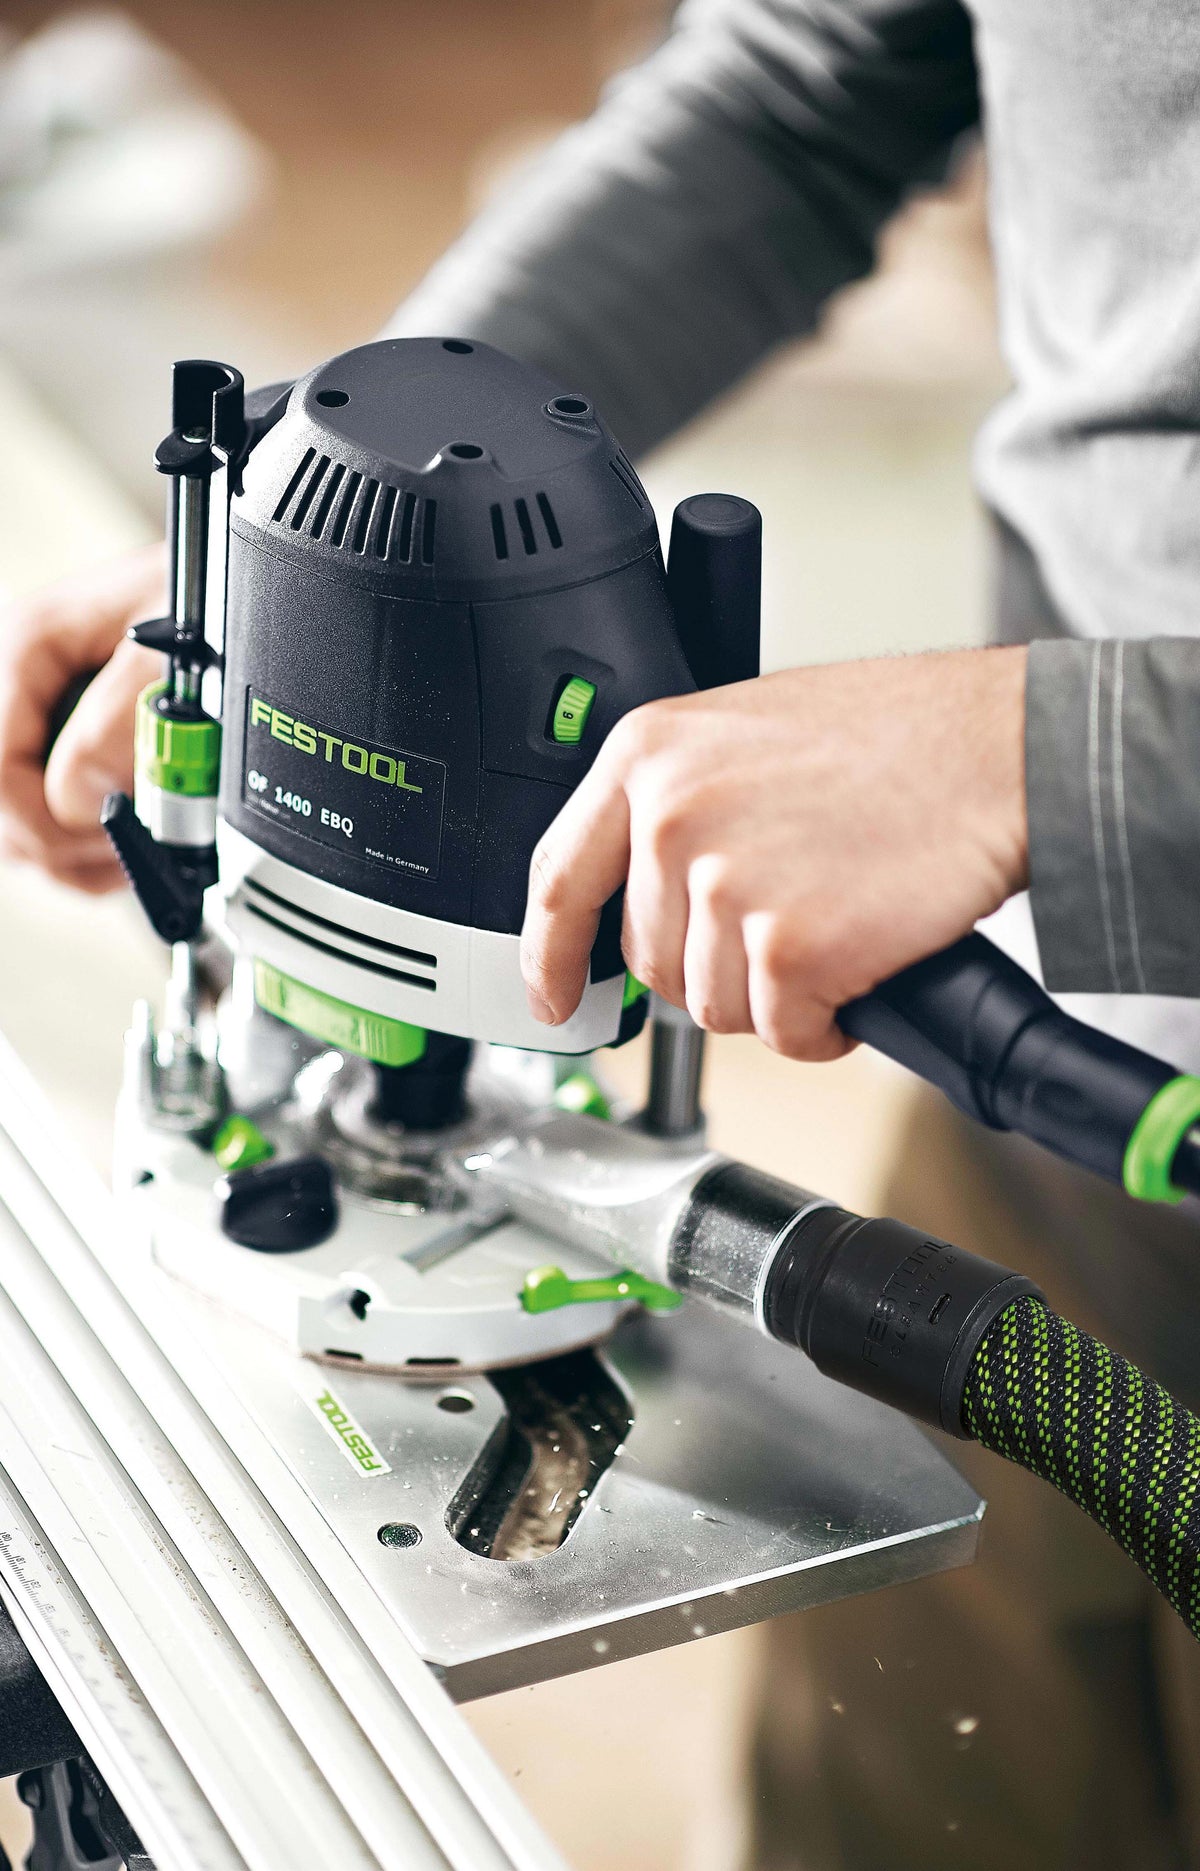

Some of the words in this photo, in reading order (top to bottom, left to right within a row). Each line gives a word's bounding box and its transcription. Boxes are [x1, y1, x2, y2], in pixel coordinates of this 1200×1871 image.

[250, 698, 423, 794] FESTOOL
[563, 711, 574, 720] 6
[274, 786, 312, 817] 1400
[320, 807, 355, 838] EBQ
[365, 847, 385, 860] Made
[386, 853, 394, 863] in
[395, 857, 430, 874] Germany
[862, 1241, 953, 1367] FESTOOL
[316, 1388, 382, 1471] FESTOOL
